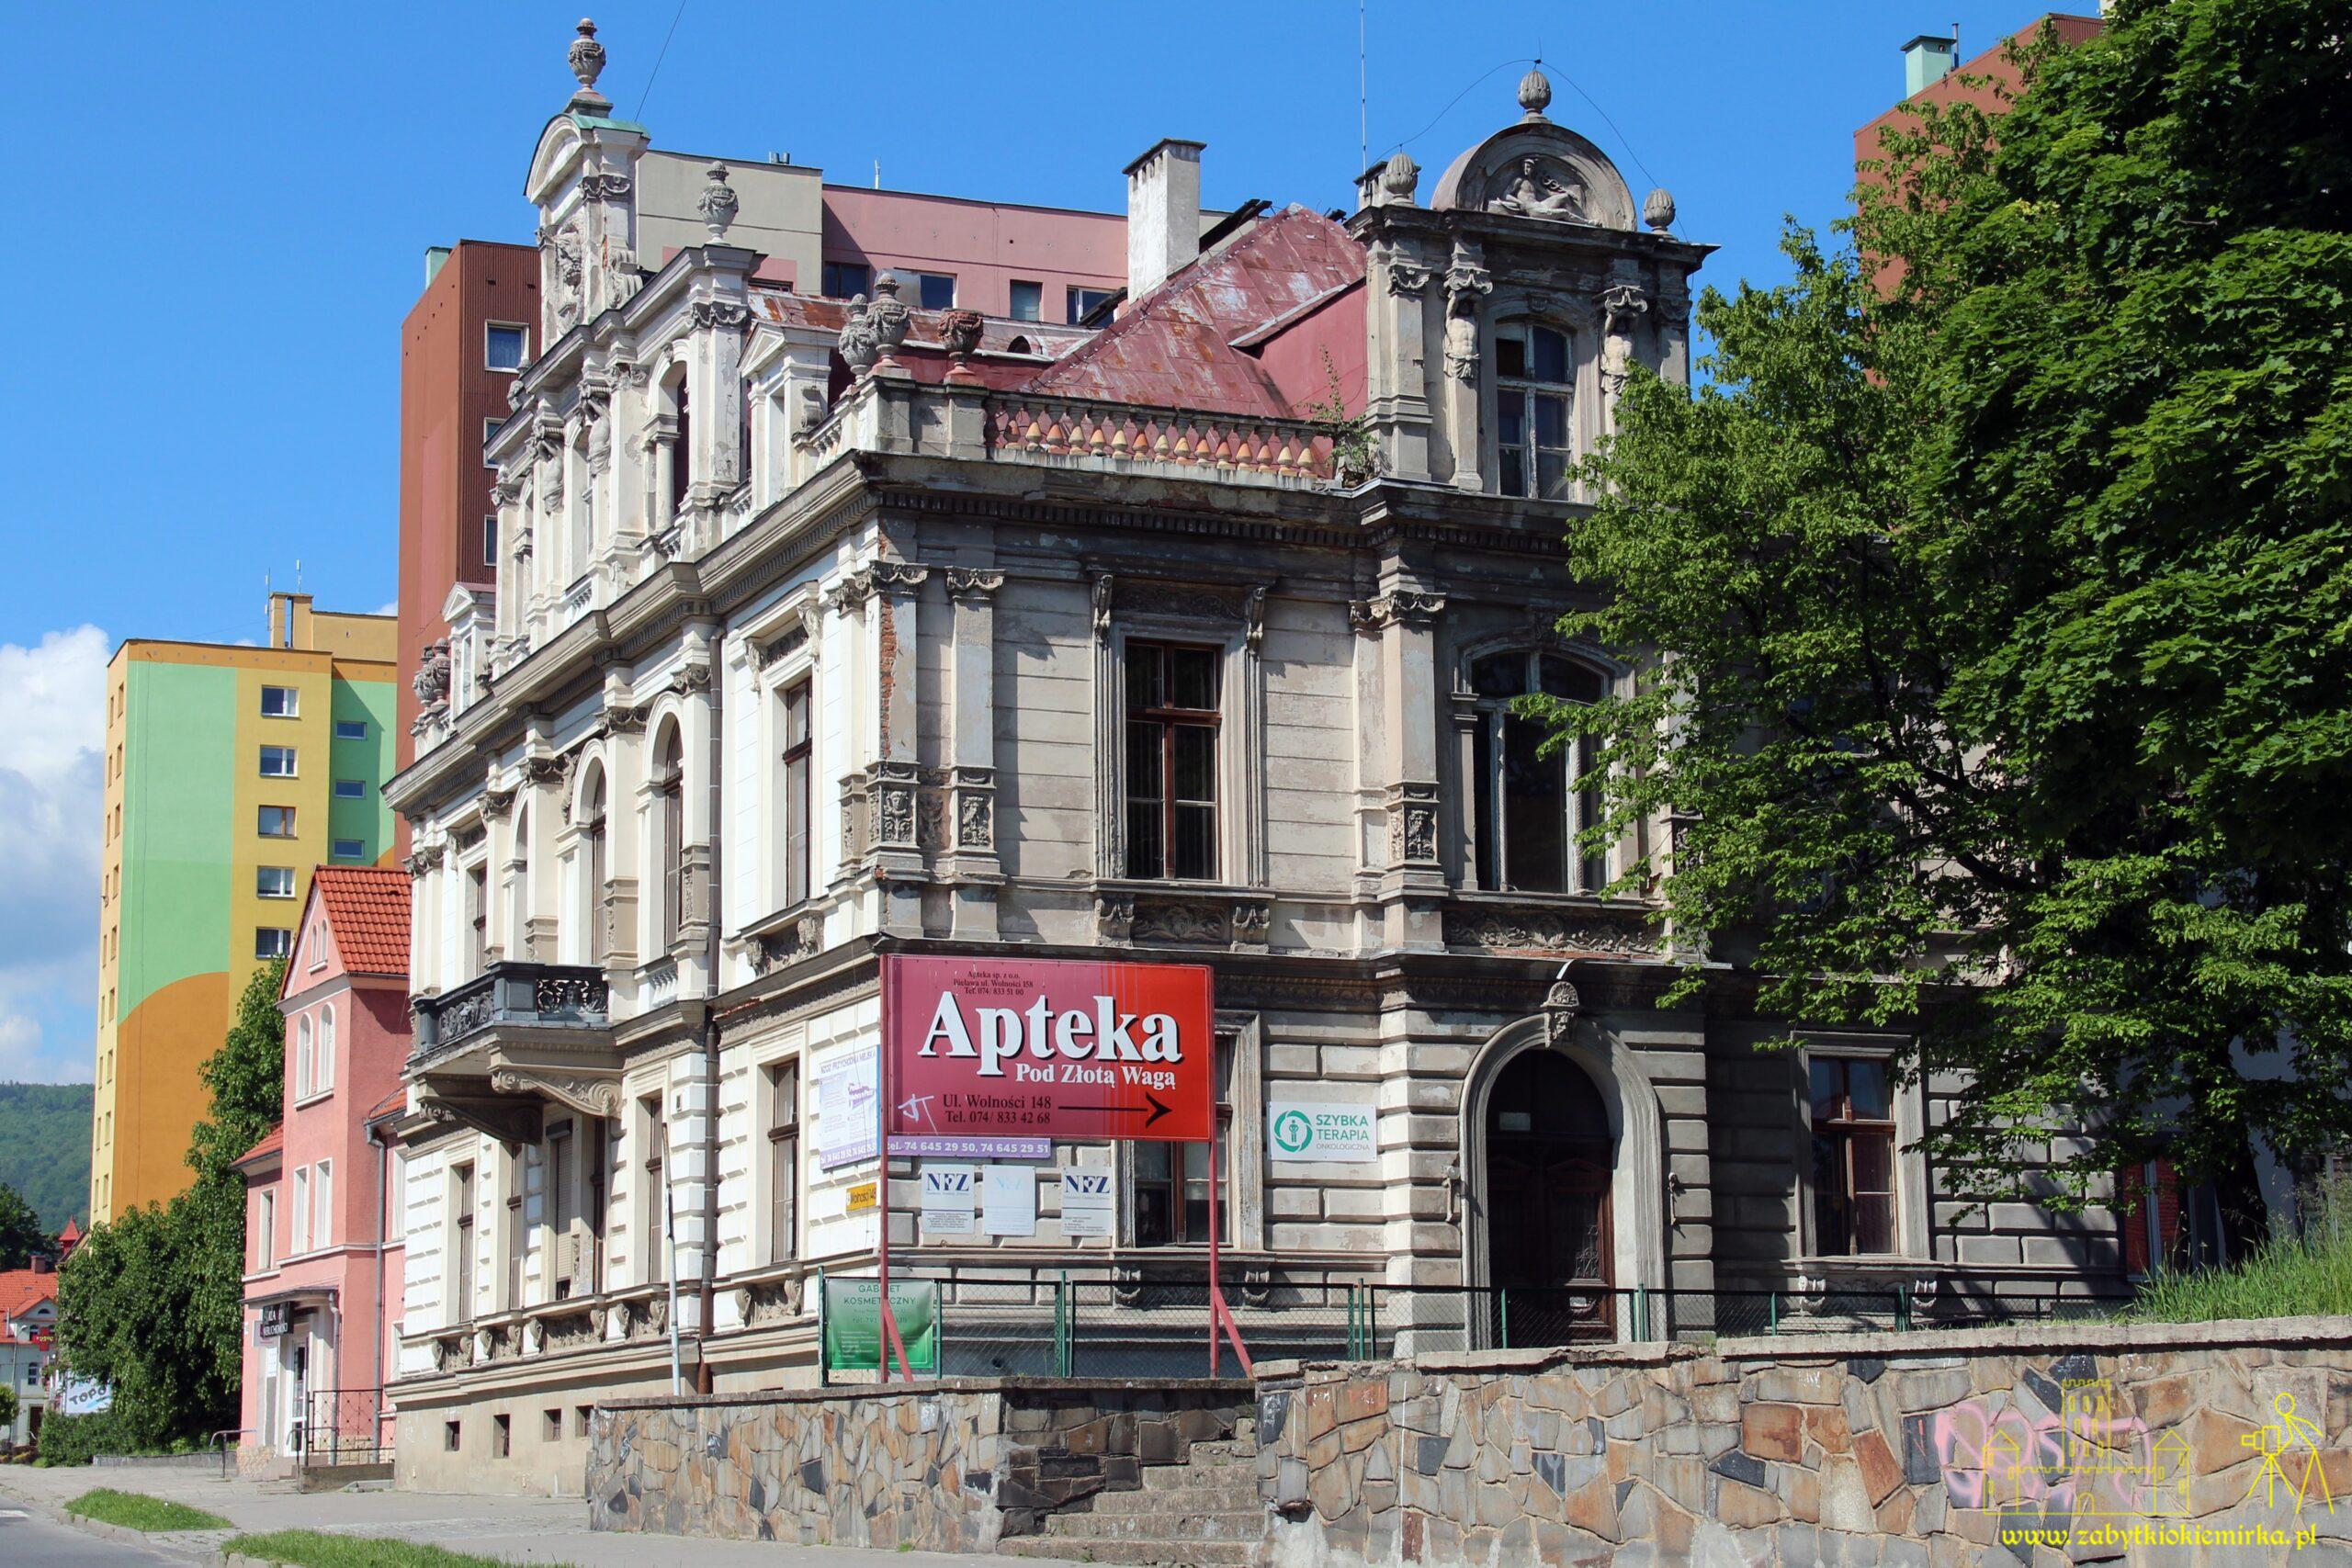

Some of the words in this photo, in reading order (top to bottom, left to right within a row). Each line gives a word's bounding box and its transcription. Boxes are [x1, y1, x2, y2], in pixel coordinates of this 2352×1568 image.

[917, 990, 1183, 1077] Apteka
[1015, 1063, 1055, 1083] Pod
[1060, 1064, 1115, 1089] Złotą
[1121, 1066, 1176, 1090] Wagą
[943, 1094, 961, 1107] Ul.
[967, 1094, 1025, 1110] Wolności
[1032, 1096, 1052, 1110] 148
[945, 1110, 966, 1122] Tel.
[969, 1111, 993, 1123] 074/
[997, 1111, 1016, 1123] 833
[1021, 1112, 1034, 1123] 42
[1037, 1112, 1051, 1123] 68
[1316, 1114, 1369, 1126] SZYBKA
[1316, 1129, 1369, 1141] TERAPIA
[904, 1142, 917, 1150] 74
[921, 1142, 942, 1151] 645
[944, 1143, 958, 1151] 29
[962, 1143, 978, 1153] 50,
[981, 1143, 993, 1152] 74
[996, 1144, 1017, 1152] 645
[1020, 1144, 1034, 1153] 29
[1036, 1145, 1049, 1153] 51
[1316, 1143, 1370, 1151] ONKOLOGICZNA
[927, 1173, 969, 1191] NFZ
[1065, 1175, 1111, 1193] NFZ
[858, 1284, 900, 1292] GABET
[843, 1296, 916, 1305] KOSMETCZNY
